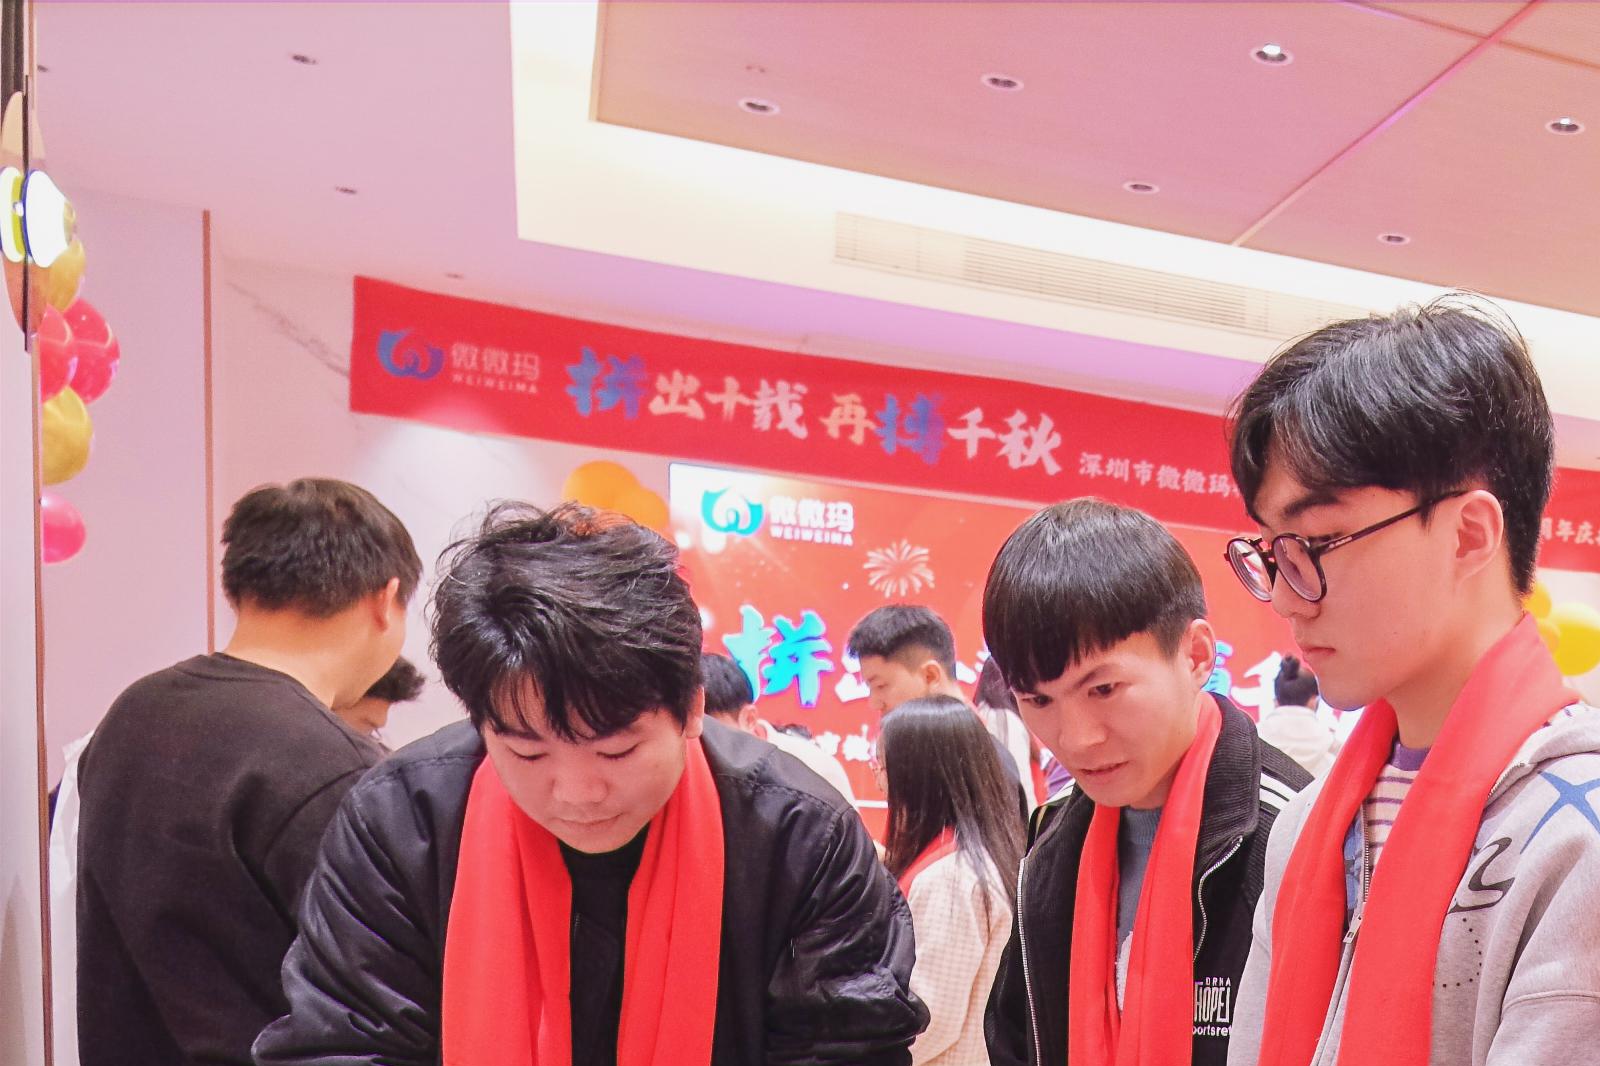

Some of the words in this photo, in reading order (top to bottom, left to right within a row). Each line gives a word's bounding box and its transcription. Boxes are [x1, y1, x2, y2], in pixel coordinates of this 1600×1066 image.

[1079, 452, 1241, 497] 深圳市微微玛
[769, 525, 853, 547] WEIWEIMA
